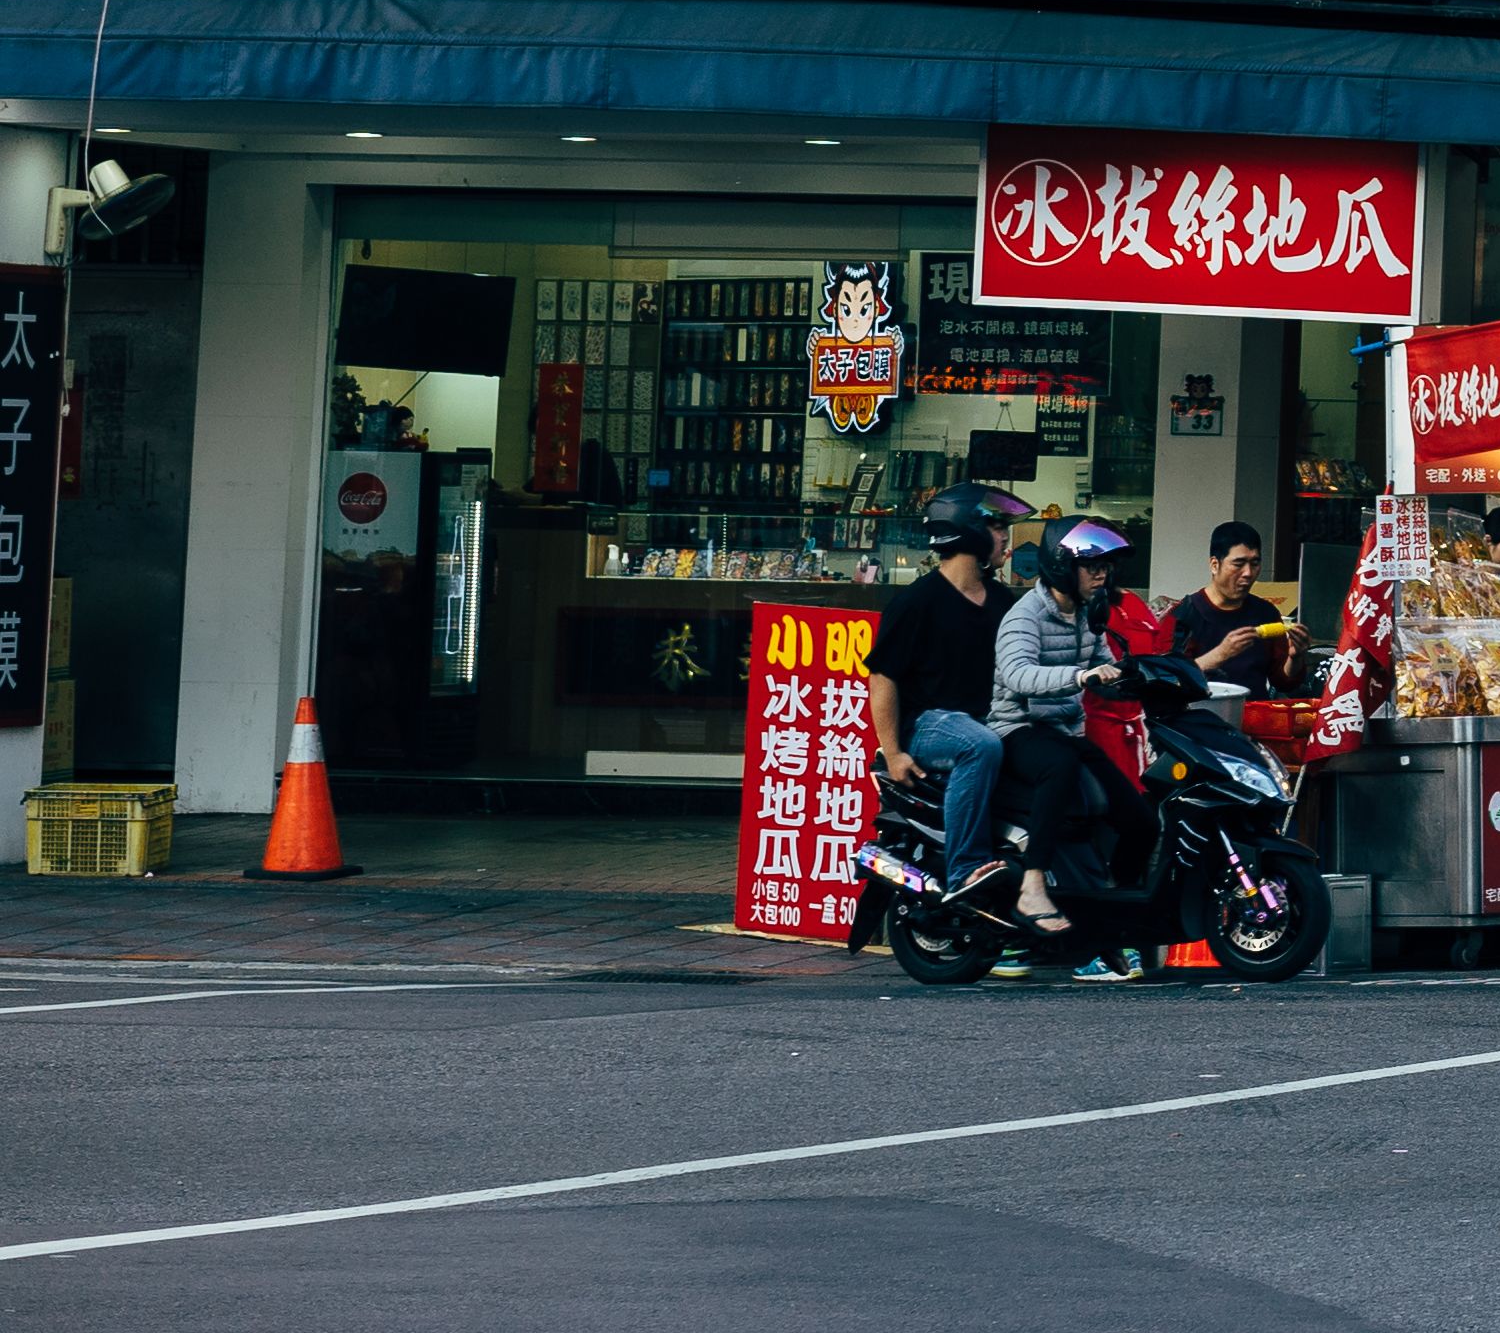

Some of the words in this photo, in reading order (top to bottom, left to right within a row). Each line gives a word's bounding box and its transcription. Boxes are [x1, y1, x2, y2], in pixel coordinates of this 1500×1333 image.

[992, 158, 1412, 279] 冰拔絲地瓜
[817, 345, 892, 384] 太子包膜
[1191, 414, 1213, 430] 33
[1395, 498, 1411, 561] 冰烤地瓜
[1411, 498, 1428, 561] 拔絲地瓜
[766, 614, 874, 676] 小明
[752, 674, 815, 879] 冰烤地瓜
[808, 677, 870, 884] 拔絲地瓜
